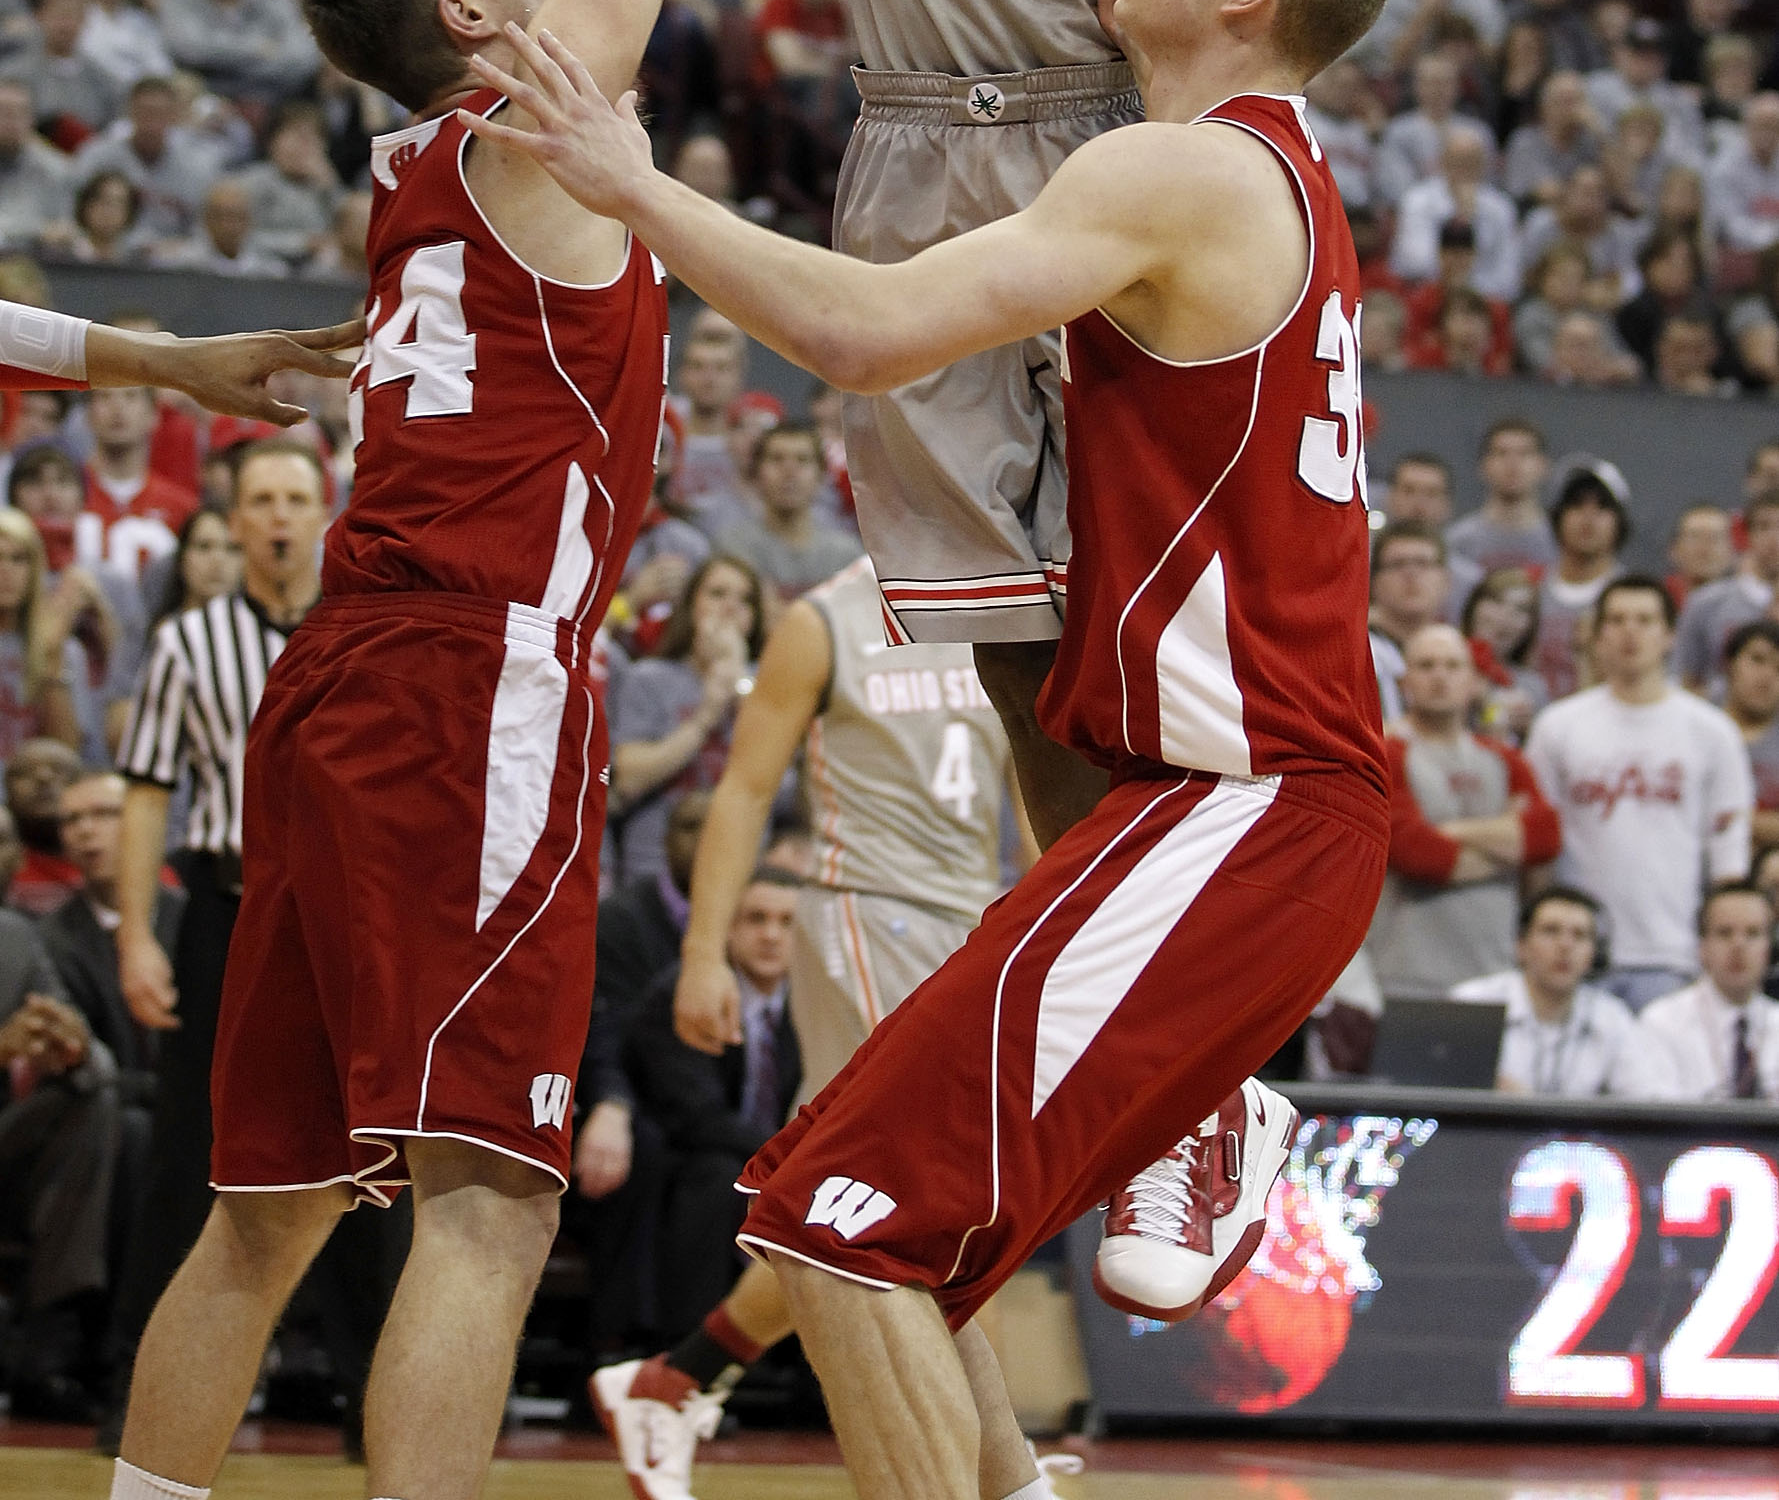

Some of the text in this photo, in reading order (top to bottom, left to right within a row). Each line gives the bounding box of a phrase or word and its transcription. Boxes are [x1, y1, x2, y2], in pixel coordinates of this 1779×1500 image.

[866, 669, 941, 715] OHIO
[932, 722, 977, 820] 4
[528, 1072, 571, 1132] W
[803, 1175, 898, 1241] W
[1506, 1136, 1779, 1413] 22
